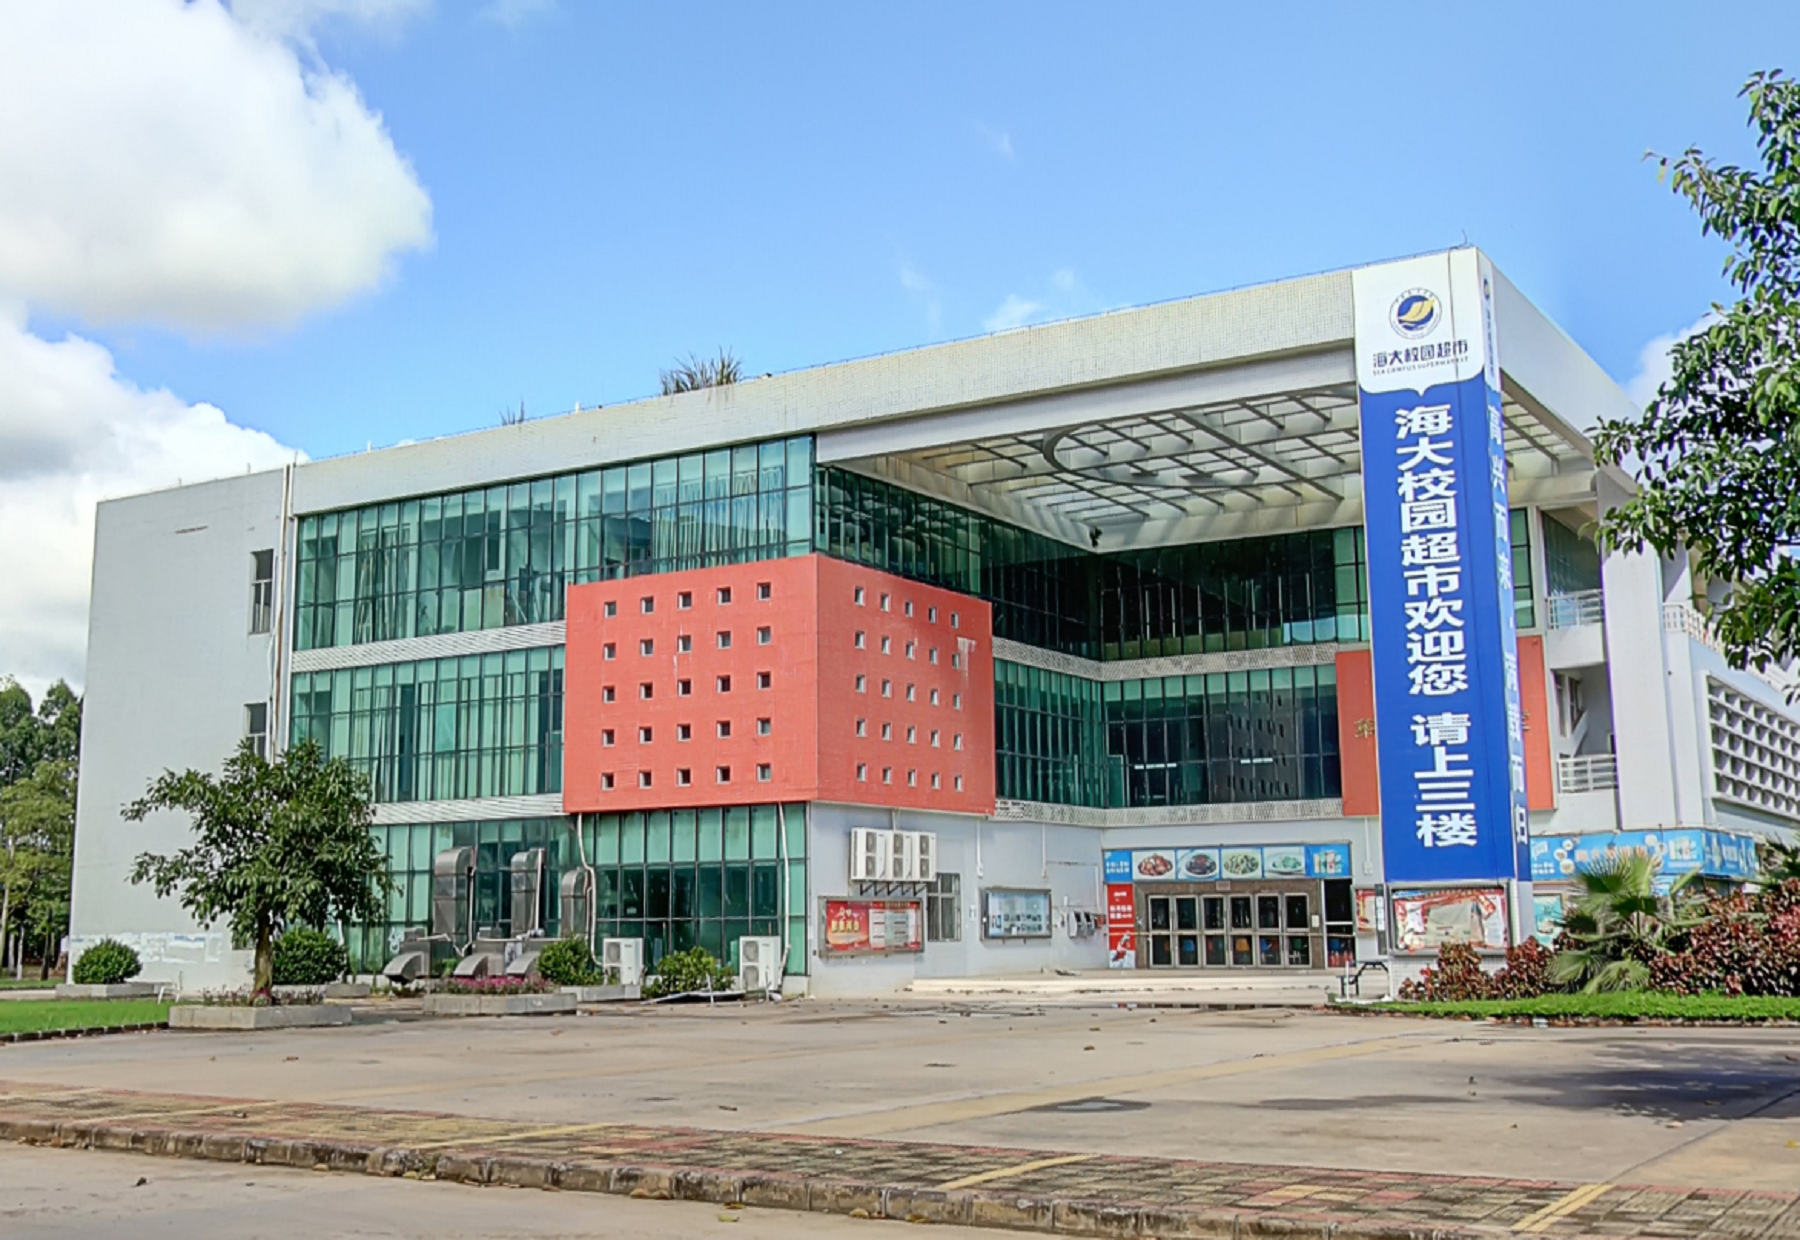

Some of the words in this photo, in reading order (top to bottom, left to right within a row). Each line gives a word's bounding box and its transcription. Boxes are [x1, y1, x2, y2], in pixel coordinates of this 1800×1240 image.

[1373, 339, 1468, 369] 海大校园超市
[1386, 363, 1417, 375] CAMPUS
[1417, 355, 1469, 371] SUPERMARKET
[1395, 404, 1468, 695] 海大校园超市欢迎您
[1411, 712, 1477, 847] 请上三楼
